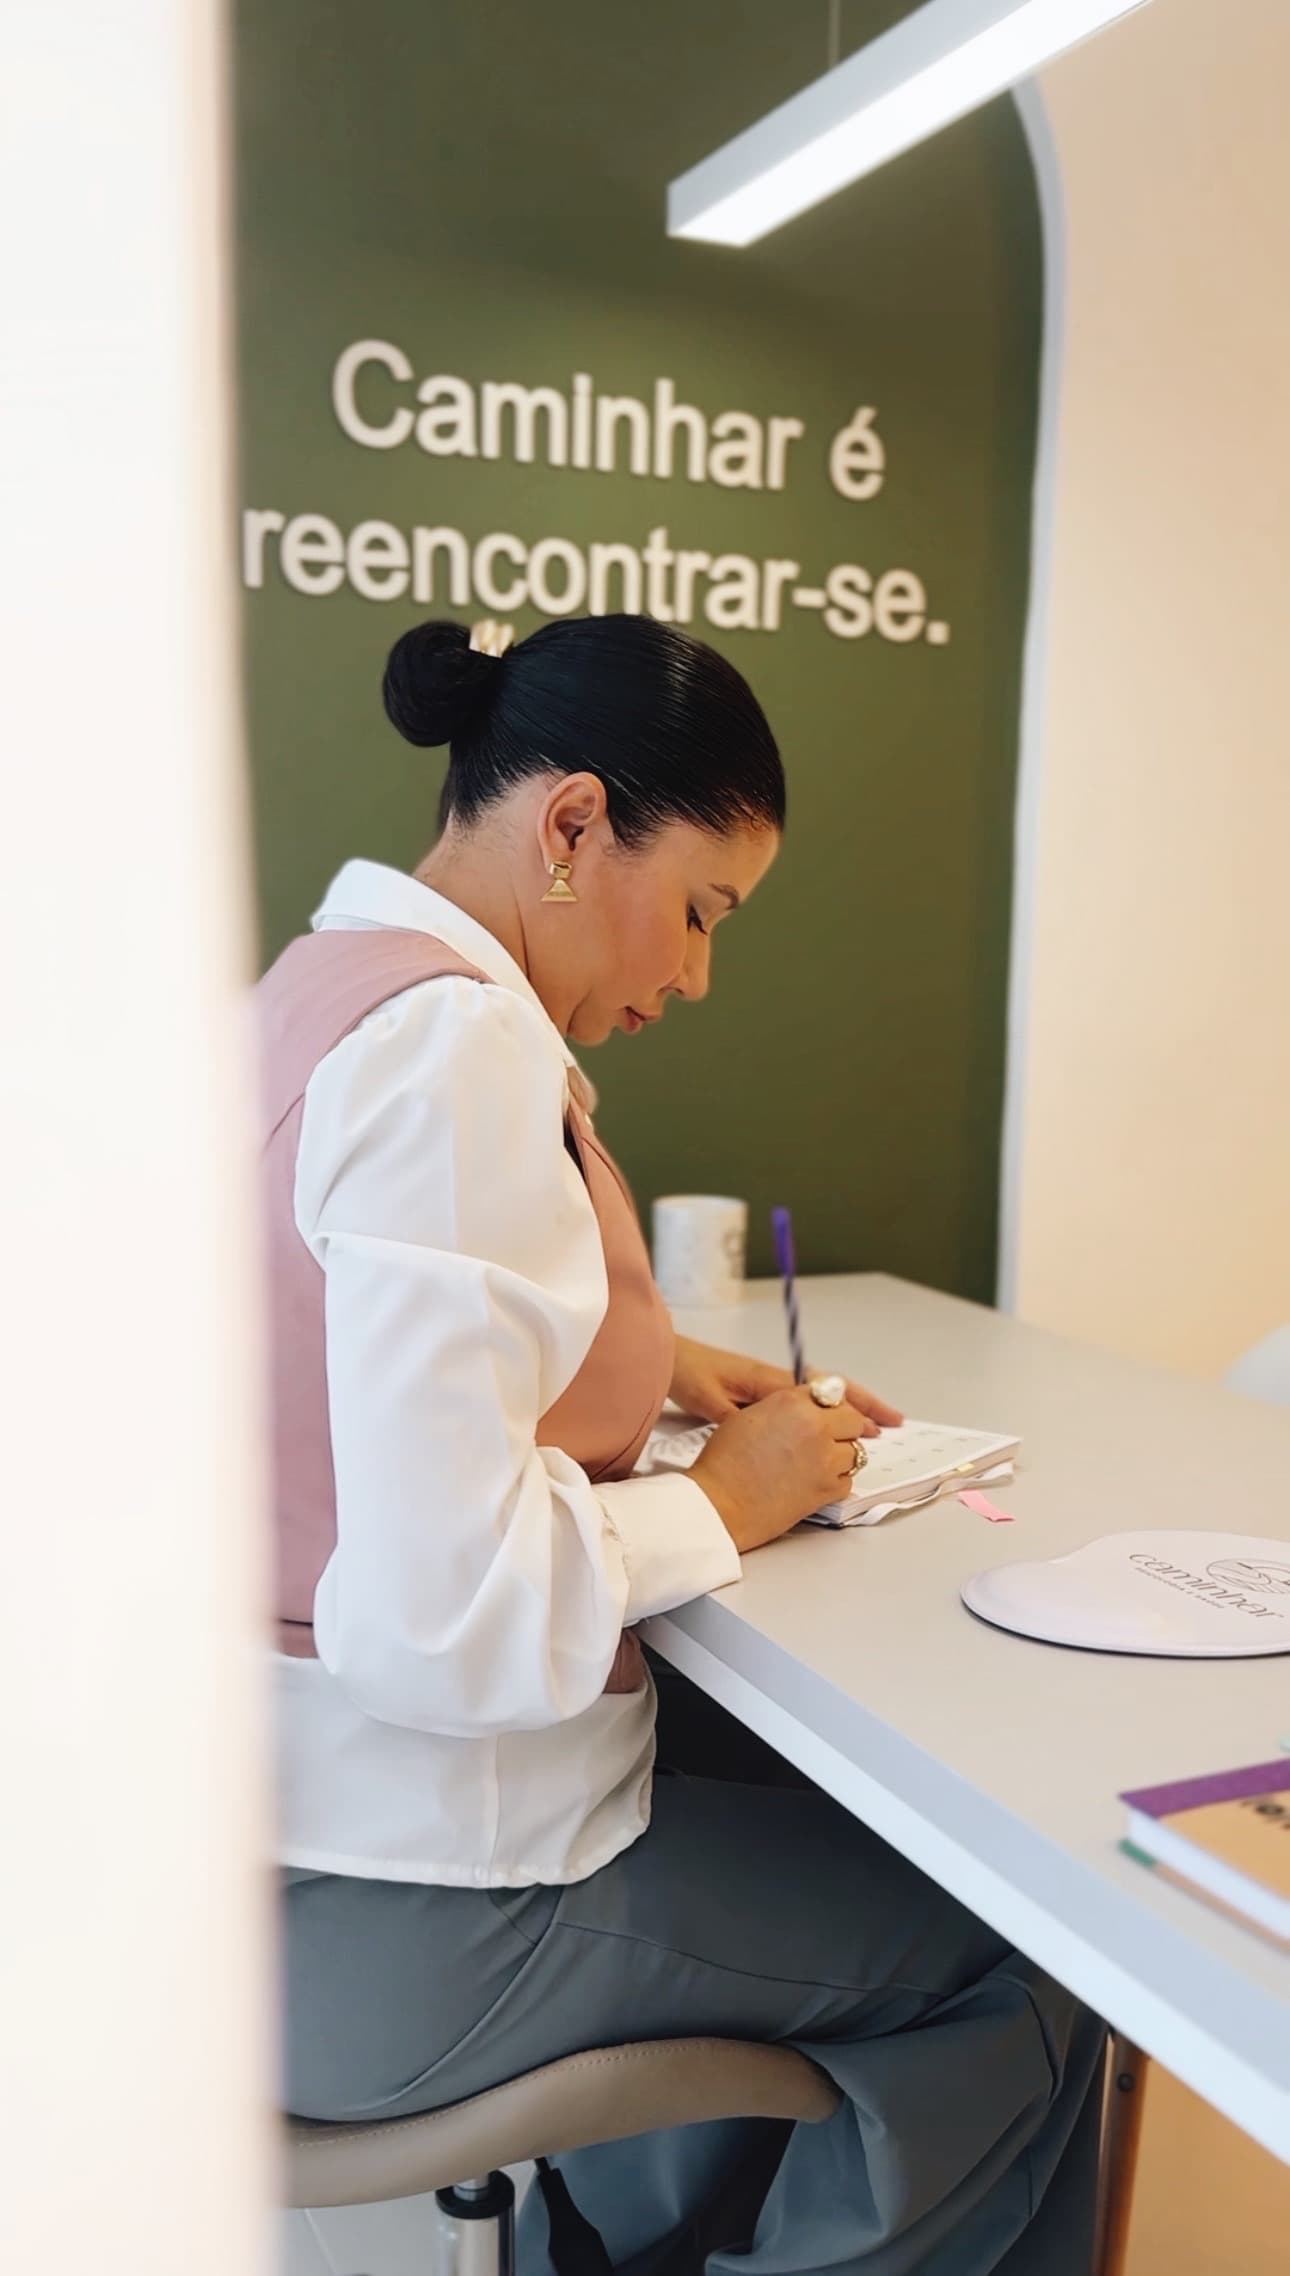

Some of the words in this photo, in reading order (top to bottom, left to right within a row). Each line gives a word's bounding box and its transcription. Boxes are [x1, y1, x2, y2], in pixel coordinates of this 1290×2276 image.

[331, 338, 804, 491] Caminhar
[829, 406, 885, 501] é
[242, 507, 950, 645] reencontrar-se.
